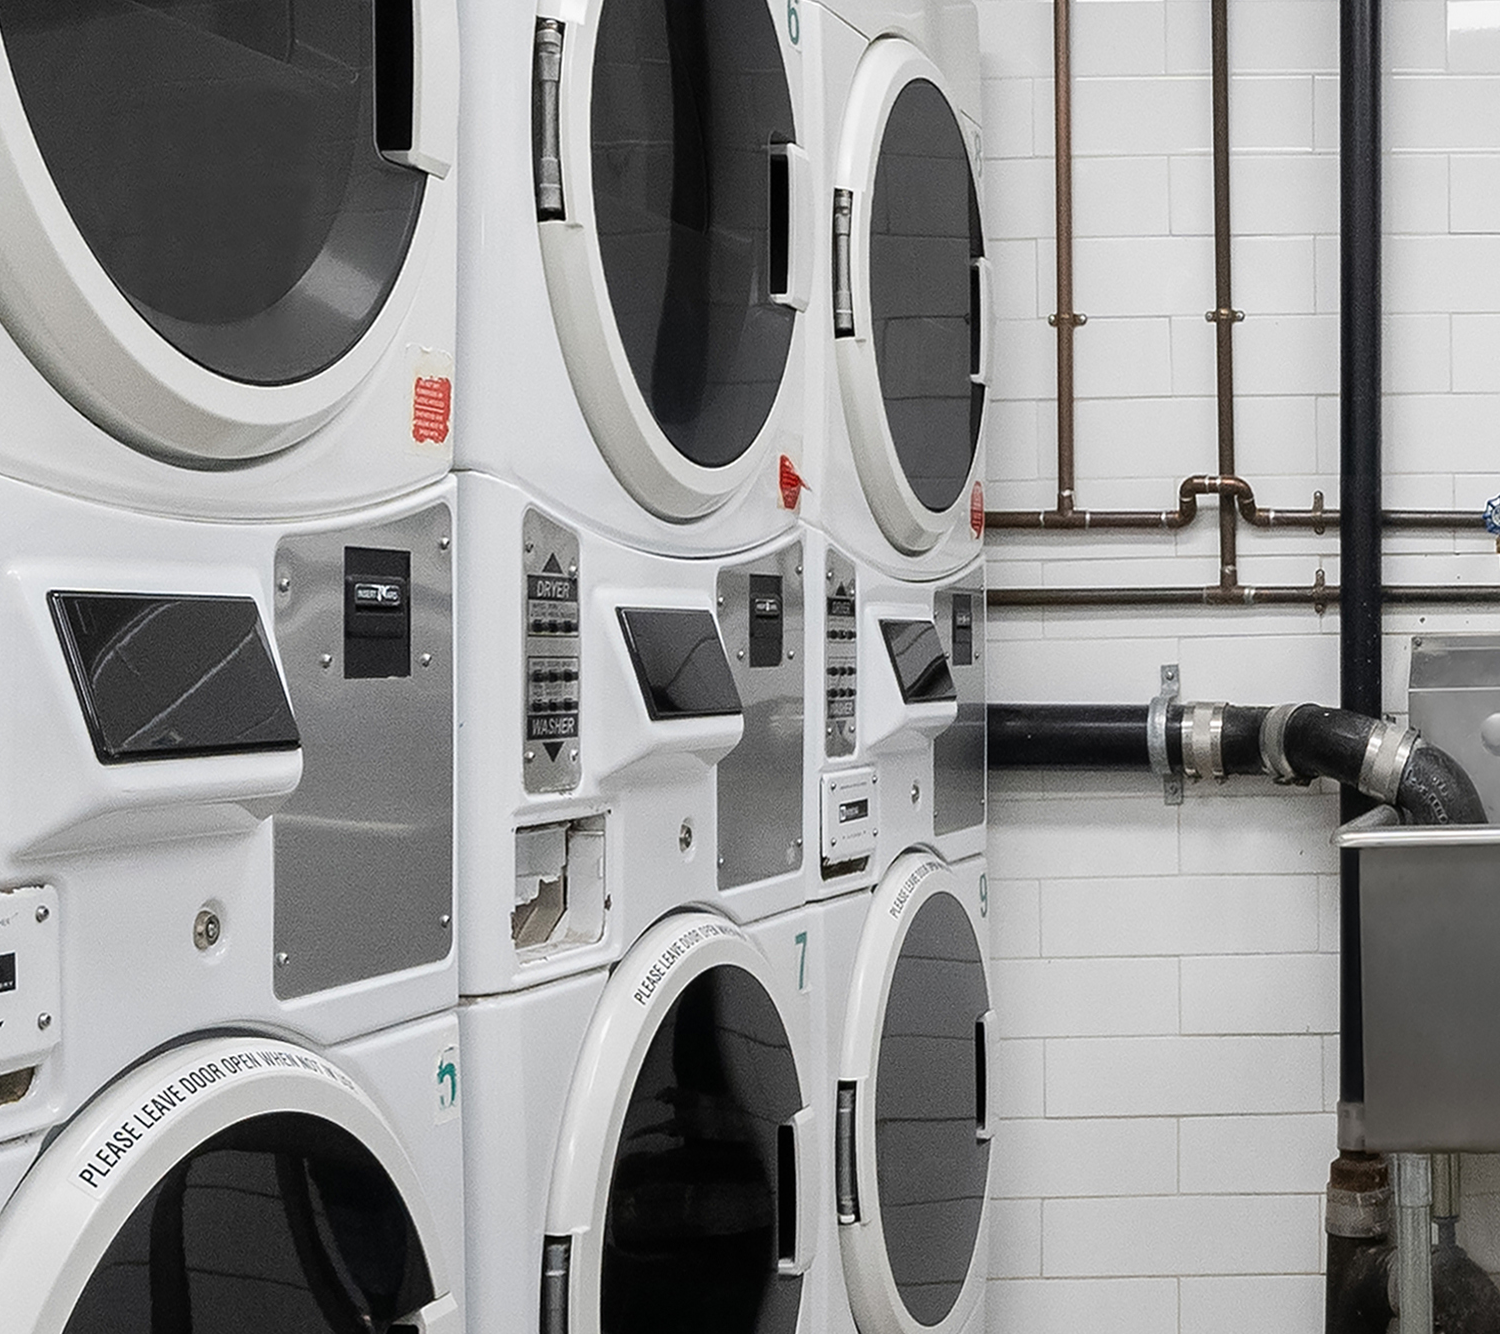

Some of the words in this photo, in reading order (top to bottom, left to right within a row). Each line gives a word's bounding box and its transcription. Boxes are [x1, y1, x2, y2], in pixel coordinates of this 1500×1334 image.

[536, 580, 570, 598] DRYER
[532, 718, 575, 736] WASHER
[980, 873, 988, 918] 9
[634, 963, 665, 1005] PLEASE
[658, 942, 685, 970] LEAVE
[795, 931, 807, 990] 7
[78, 1121, 143, 1189] PLEASE
[140, 1085, 187, 1129] LEAVE
[178, 1063, 225, 1095] DOOR
[220, 1051, 263, 1075] OPEN
[261, 1051, 304, 1068] WHEN
